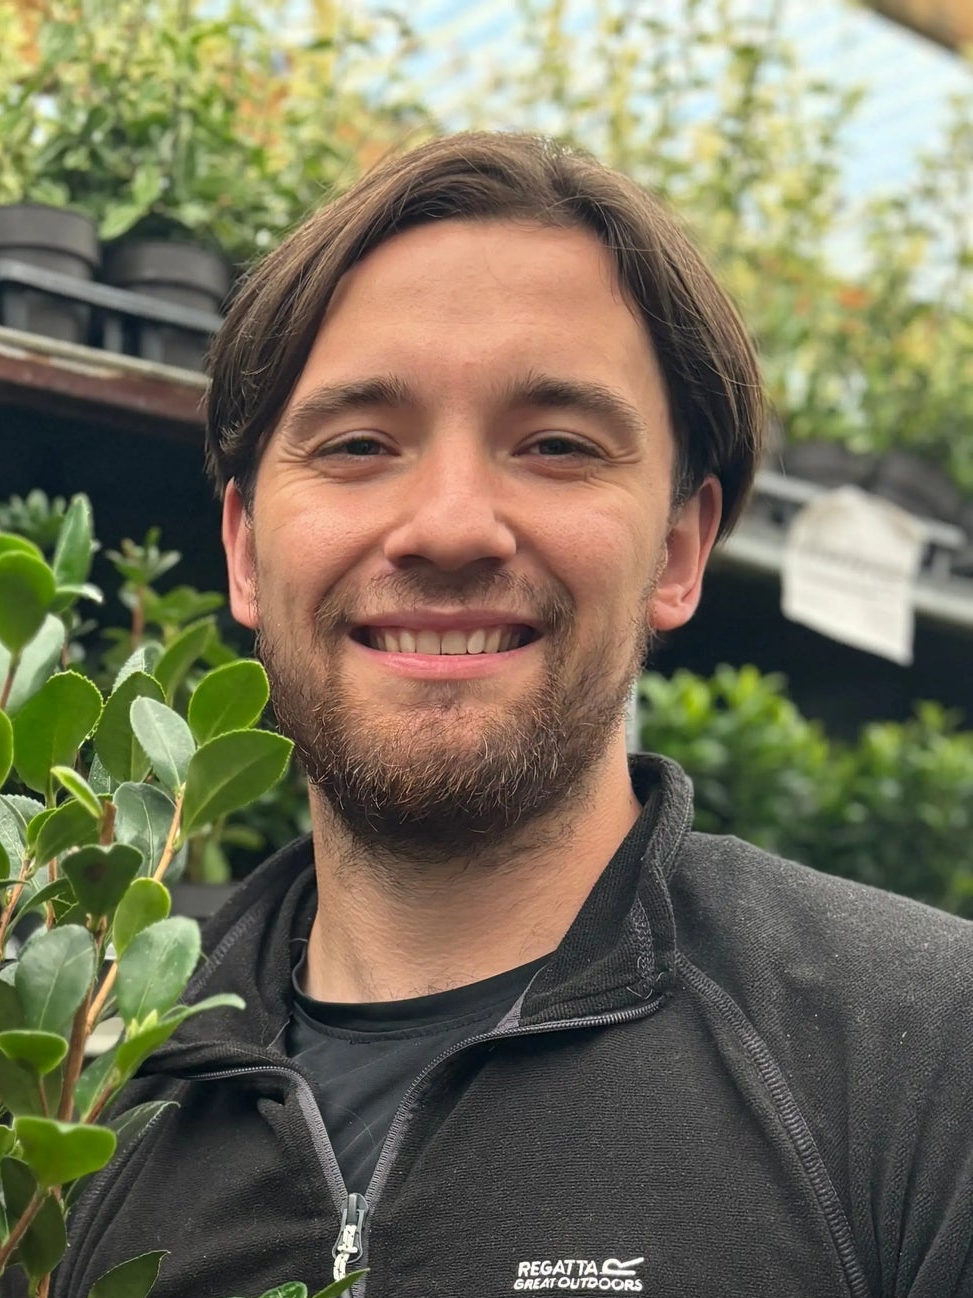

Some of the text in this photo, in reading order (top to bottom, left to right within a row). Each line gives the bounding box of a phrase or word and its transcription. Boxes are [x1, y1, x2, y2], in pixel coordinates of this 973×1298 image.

[518, 1259, 598, 1277] REGATTA
[513, 1277, 643, 1291] GREAT OUTDOORS
